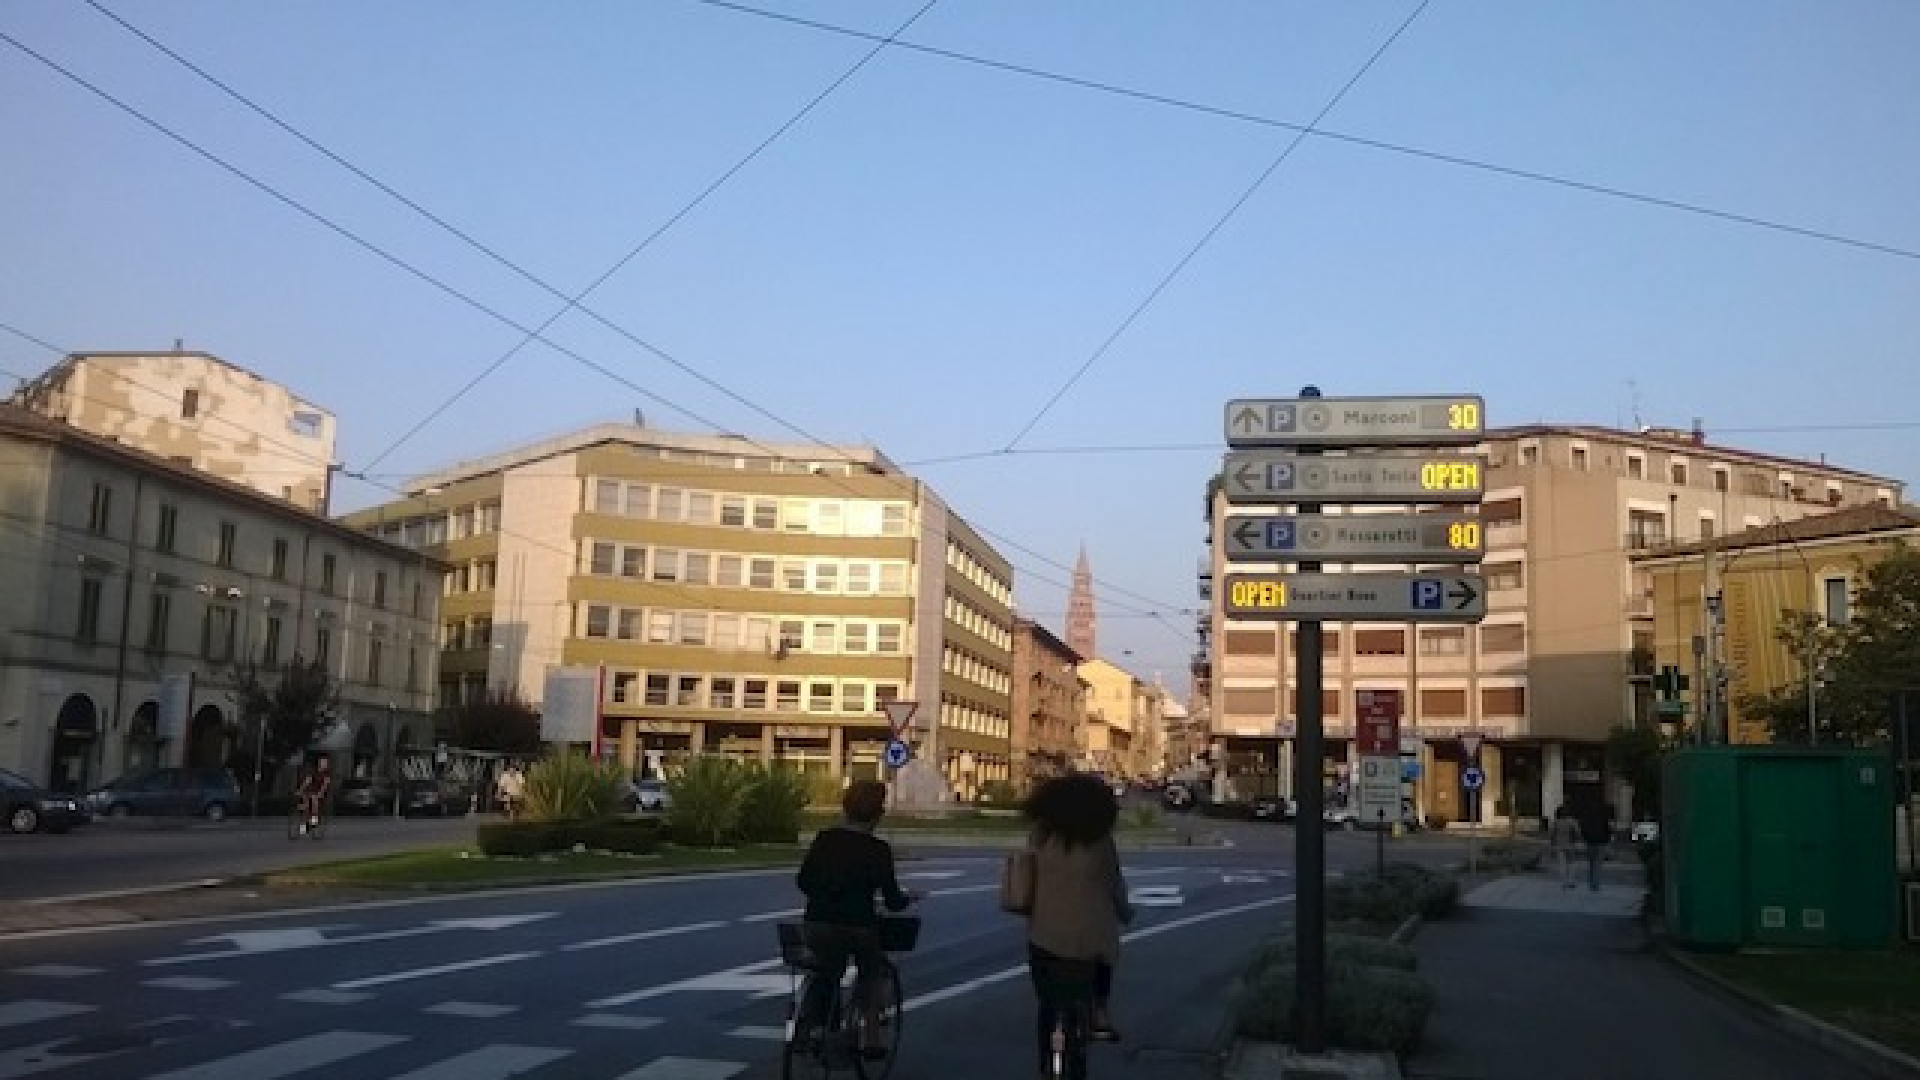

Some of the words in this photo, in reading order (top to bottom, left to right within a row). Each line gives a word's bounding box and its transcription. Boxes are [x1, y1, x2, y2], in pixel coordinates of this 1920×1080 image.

[1343, 410, 1417, 425] Marconi
[1449, 404, 1478, 430] 30
[1272, 464, 1291, 488] P
[1421, 461, 1479, 490] OPEN
[1448, 522, 1479, 549] 80
[1232, 581, 1286, 607] OPEN
[1419, 583, 1439, 606] P
